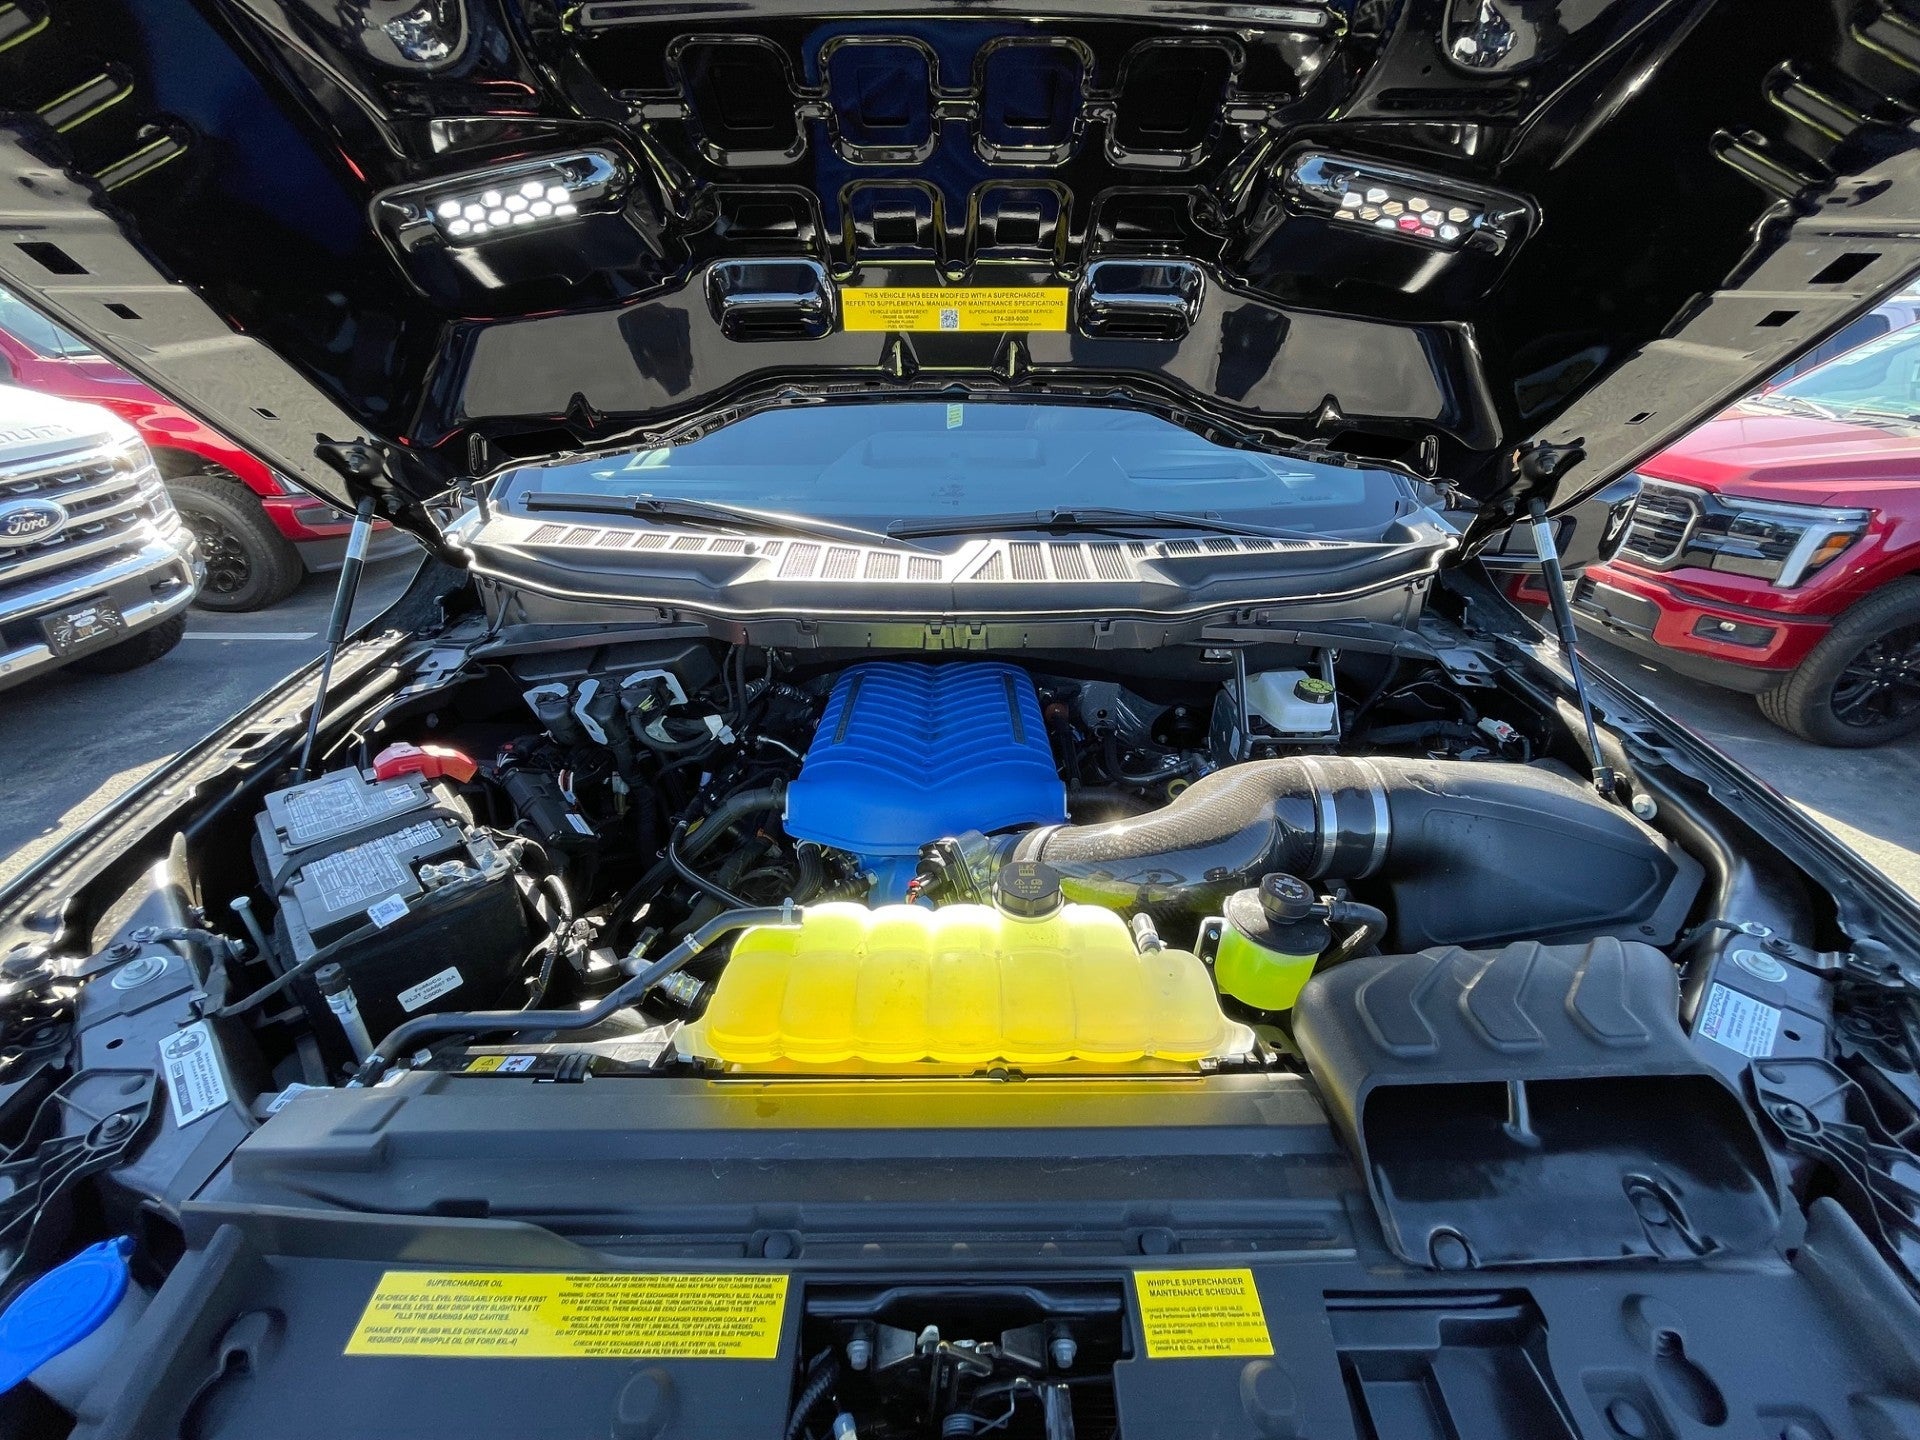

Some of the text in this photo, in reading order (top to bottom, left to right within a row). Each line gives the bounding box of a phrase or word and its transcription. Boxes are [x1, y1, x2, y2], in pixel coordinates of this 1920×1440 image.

[8, 512, 50, 535] Ford
[201, 1074, 215, 1106] AMERICAN
[426, 1279, 490, 1287] SUPERCHARGER
